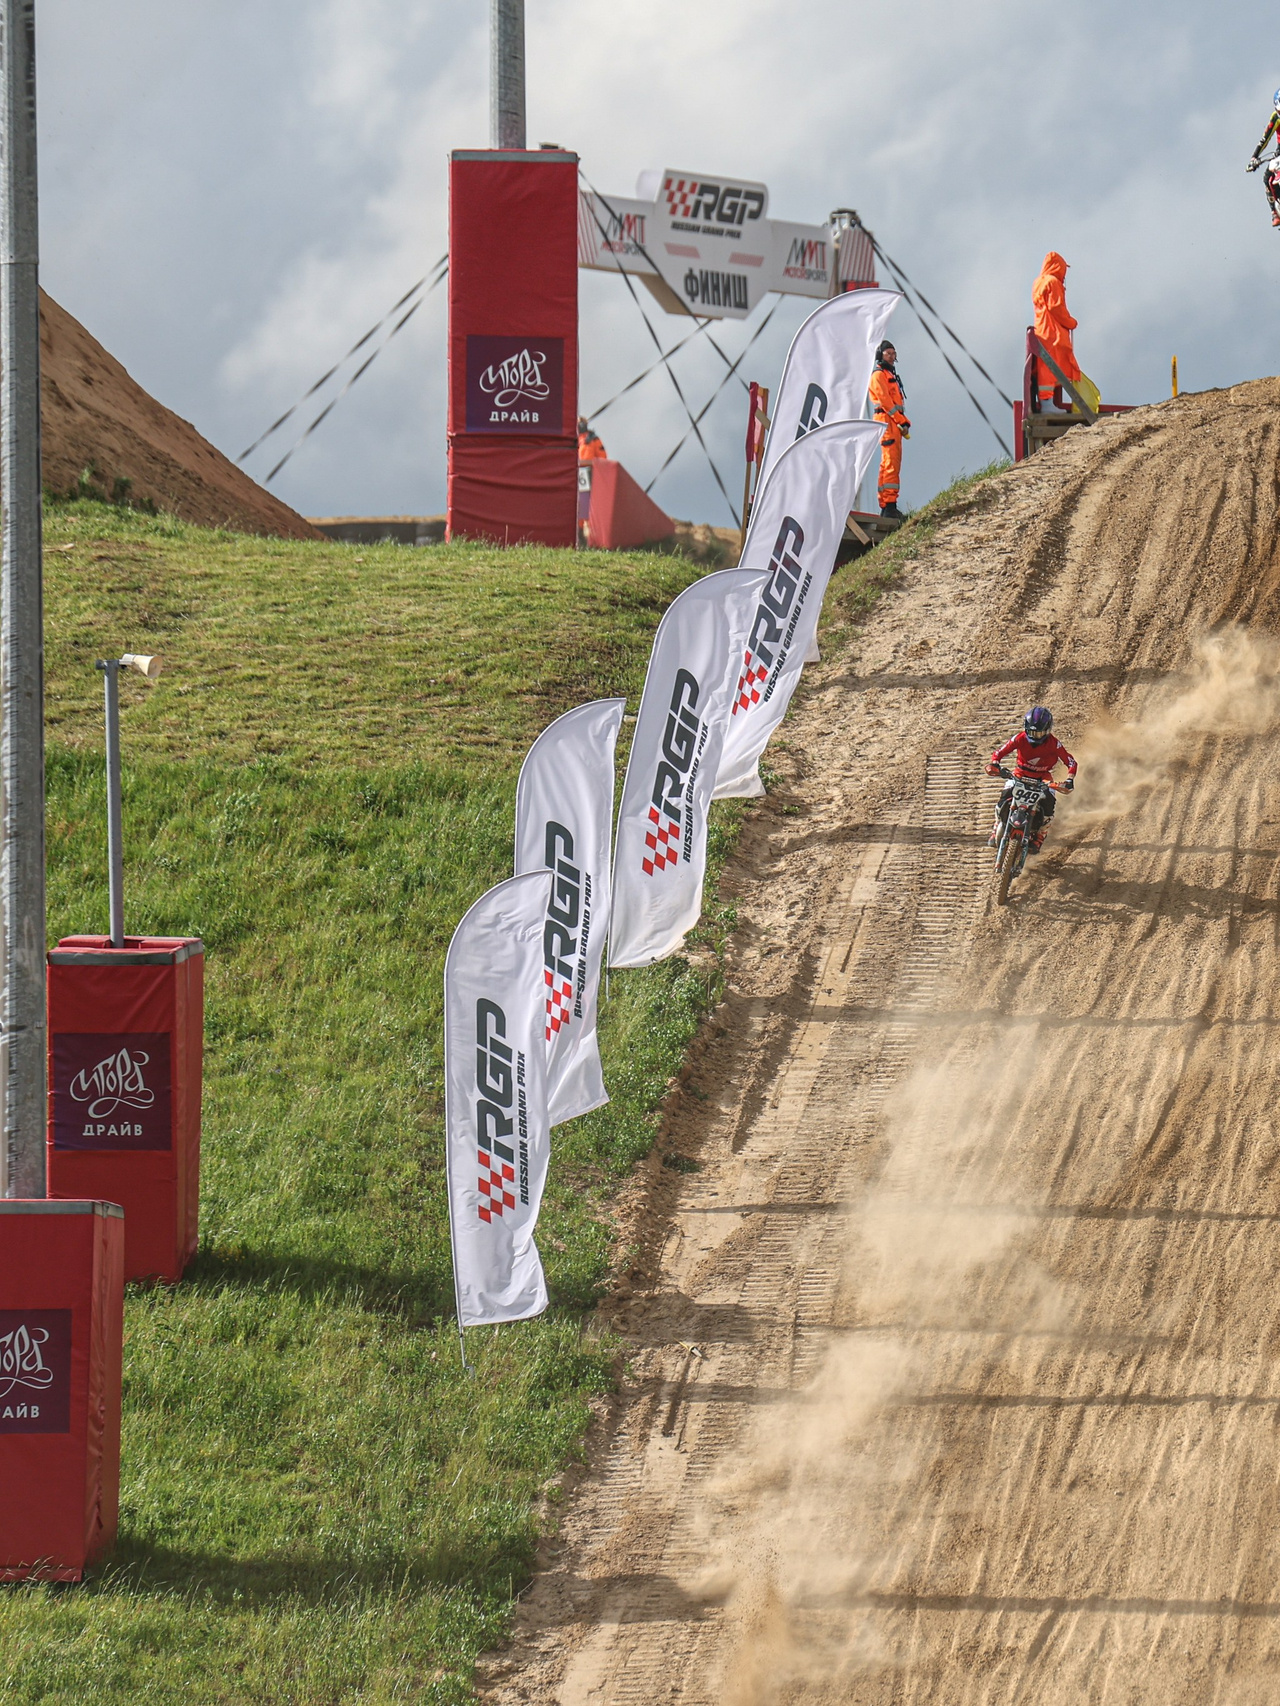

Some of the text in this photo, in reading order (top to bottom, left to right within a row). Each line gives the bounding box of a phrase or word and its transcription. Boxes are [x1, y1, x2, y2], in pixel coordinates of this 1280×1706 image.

[671, 220, 742, 239] RUSSIAN GRAND PRIX
[691, 183, 765, 225] RGP
[684, 268, 748, 310] ФИНИШ
[489, 409, 540, 423] ДРАЙВ
[748, 516, 805, 668] RGP
[764, 571, 813, 703] RUSSIAN GRAND PRIX
[651, 668, 700, 823] RGP
[682, 722, 709, 864] RUSSIAN GRAND PRIX
[1015, 789, 1040, 804] 949
[544, 821, 581, 981] RGP
[573, 872, 592, 1019] RUSSIAN GRAND PRIX
[82, 1121, 143, 1136] ДРАЙВ
[476, 997, 515, 1164] RGP
[517, 1051, 529, 1206] RUSSIAN GRAND PRIX
[0, 1402, 40, 1419] АЙВ
